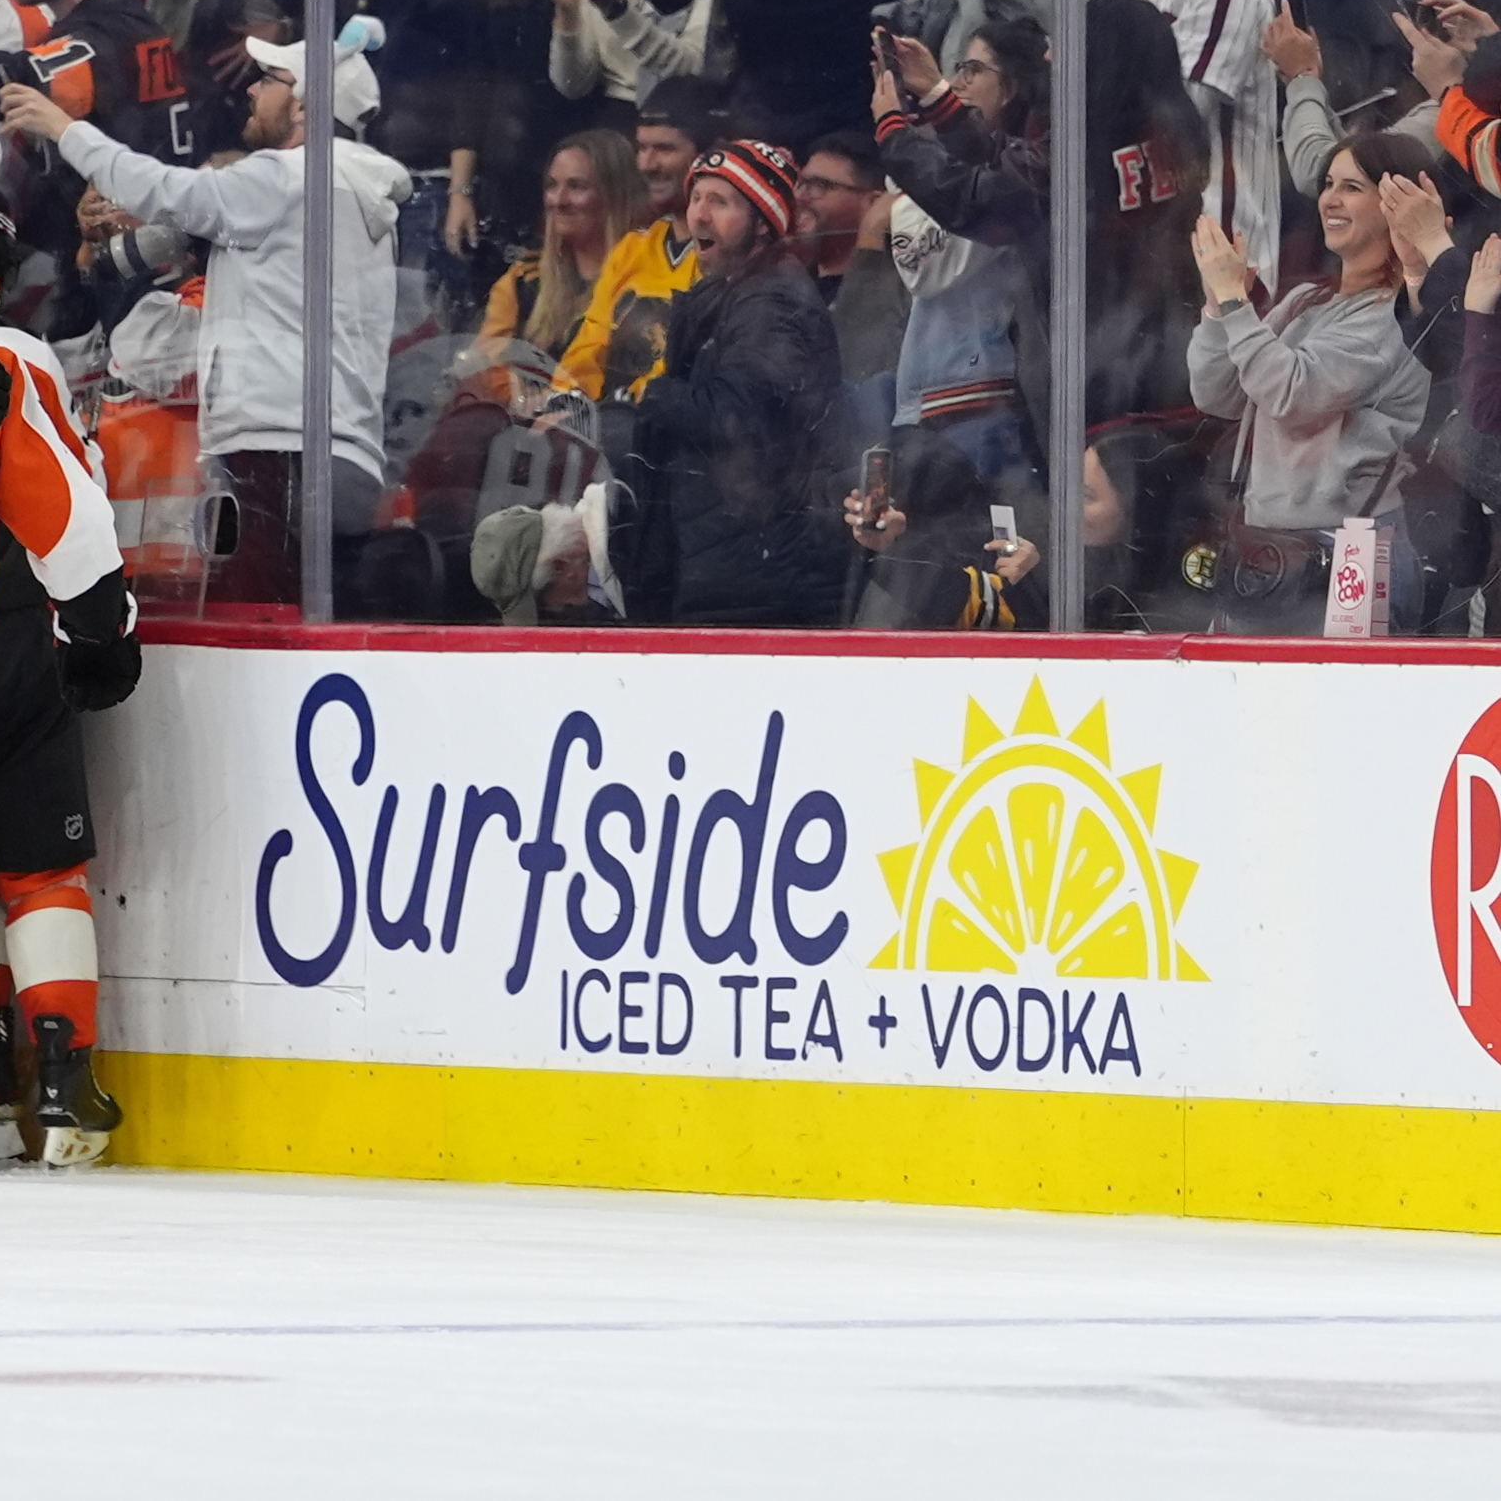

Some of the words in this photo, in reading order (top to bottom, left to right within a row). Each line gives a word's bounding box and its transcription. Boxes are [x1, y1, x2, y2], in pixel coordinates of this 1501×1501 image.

[255, 672, 849, 995] Surfside
[560, 968, 694, 1056] ICED
[720, 976, 843, 1062] TEA
[920, 983, 1142, 1078] VODKA
